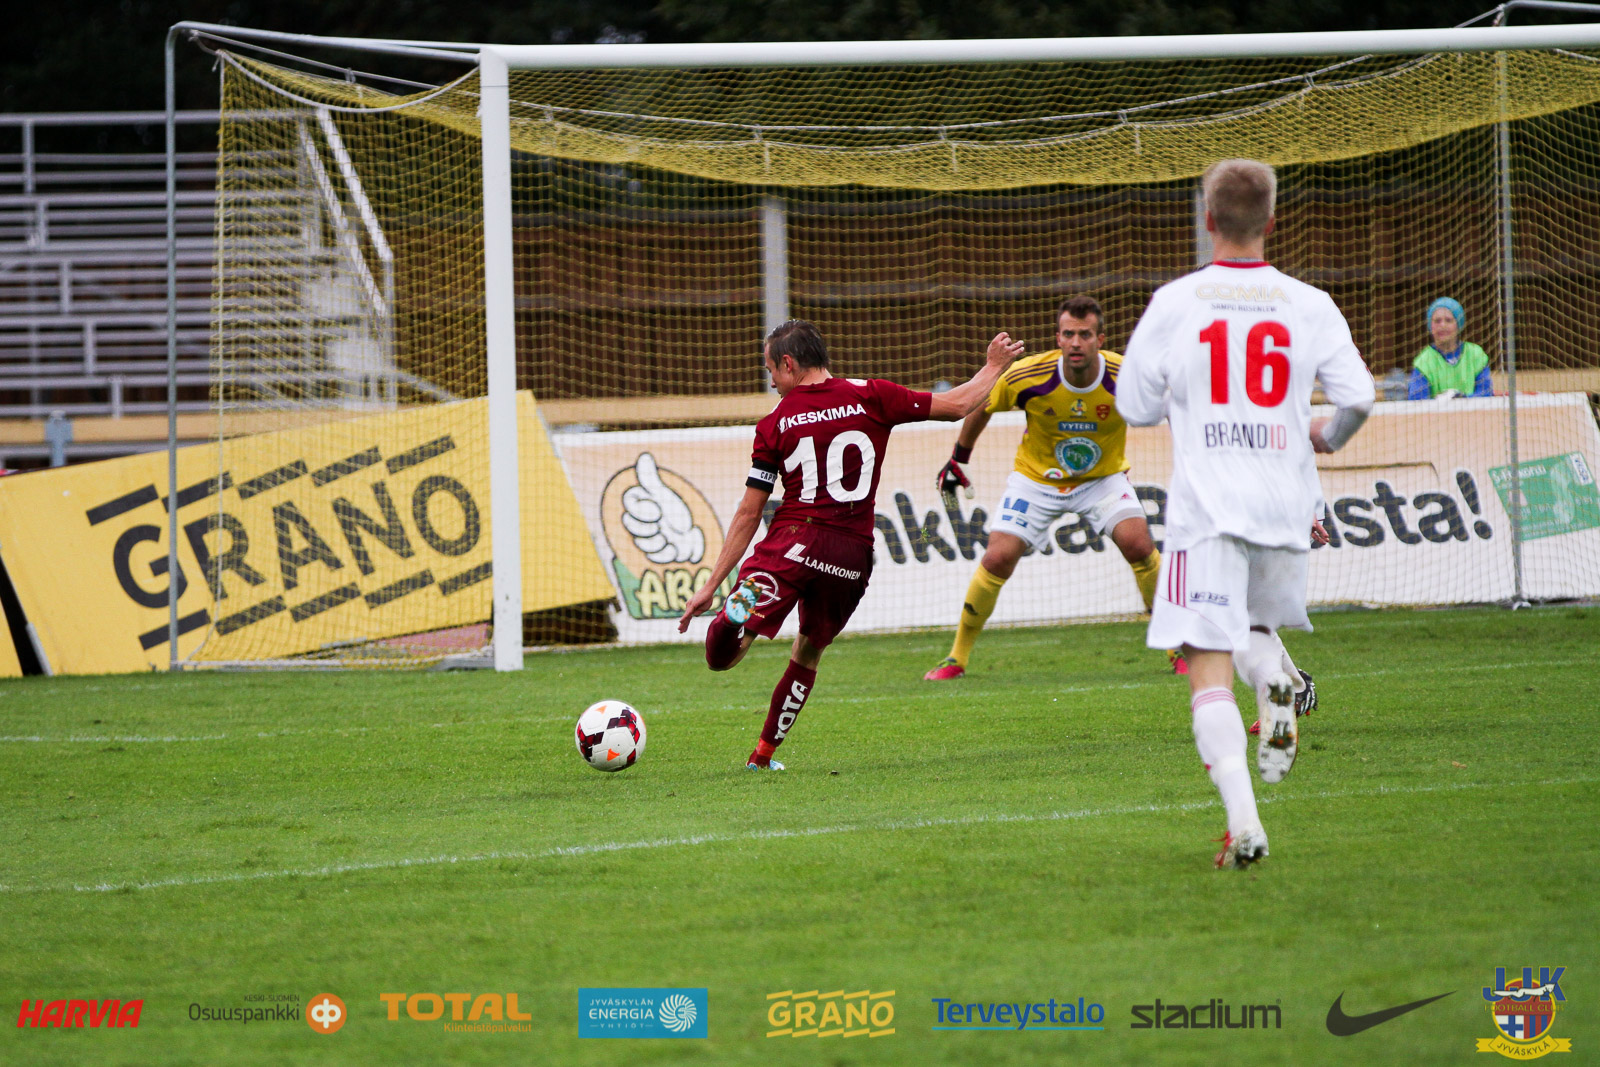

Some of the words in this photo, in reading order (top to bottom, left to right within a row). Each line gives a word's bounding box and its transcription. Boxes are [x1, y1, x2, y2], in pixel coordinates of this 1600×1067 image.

[1195, 282, 1291, 303] COMIA
[1199, 319, 1291, 408] 16
[787, 403, 866, 428] KESKIMAA
[784, 430, 876, 503] 10
[112, 474, 481, 609] GRANO
[804, 556, 861, 580] LAAKKONEN
